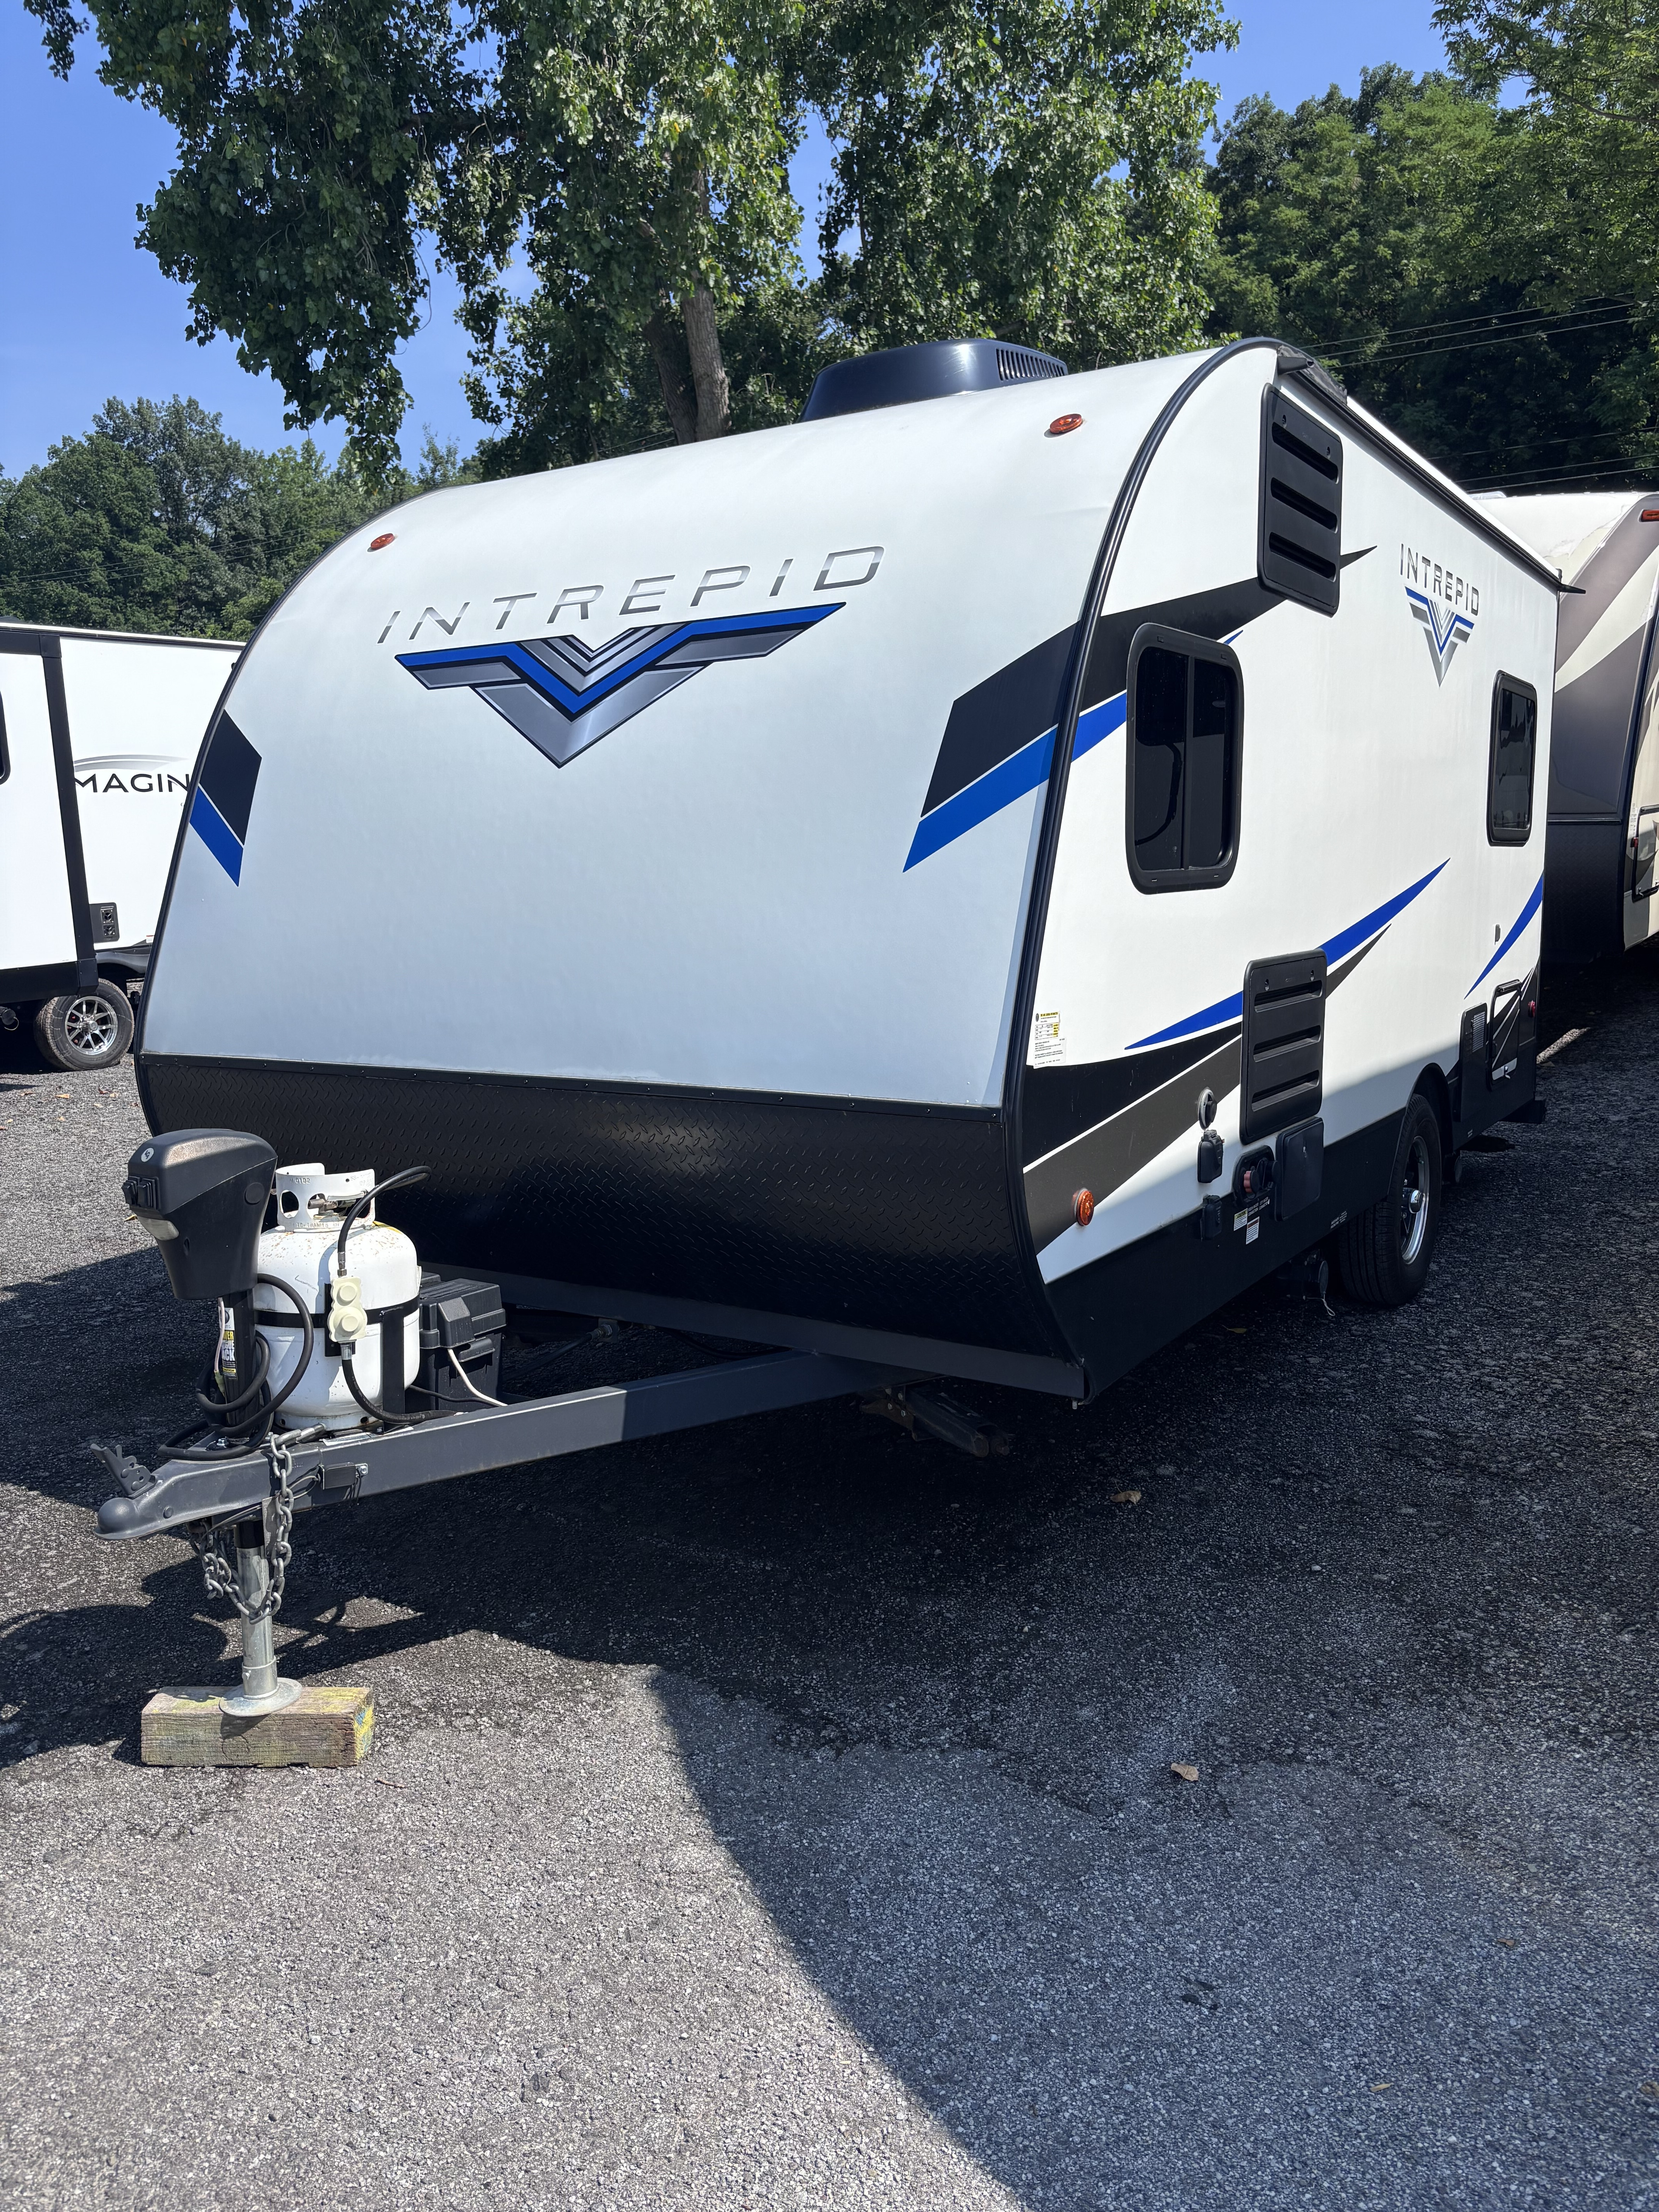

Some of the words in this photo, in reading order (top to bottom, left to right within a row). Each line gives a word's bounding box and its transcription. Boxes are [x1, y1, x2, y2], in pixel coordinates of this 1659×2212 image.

[1400, 543, 1479, 616] INTREPID
[376, 546, 885, 644] INTREPID
[74, 773, 190, 793] MAGIN
[223, 1331, 234, 1340] WER
[222, 1350, 235, 1361] ACK
